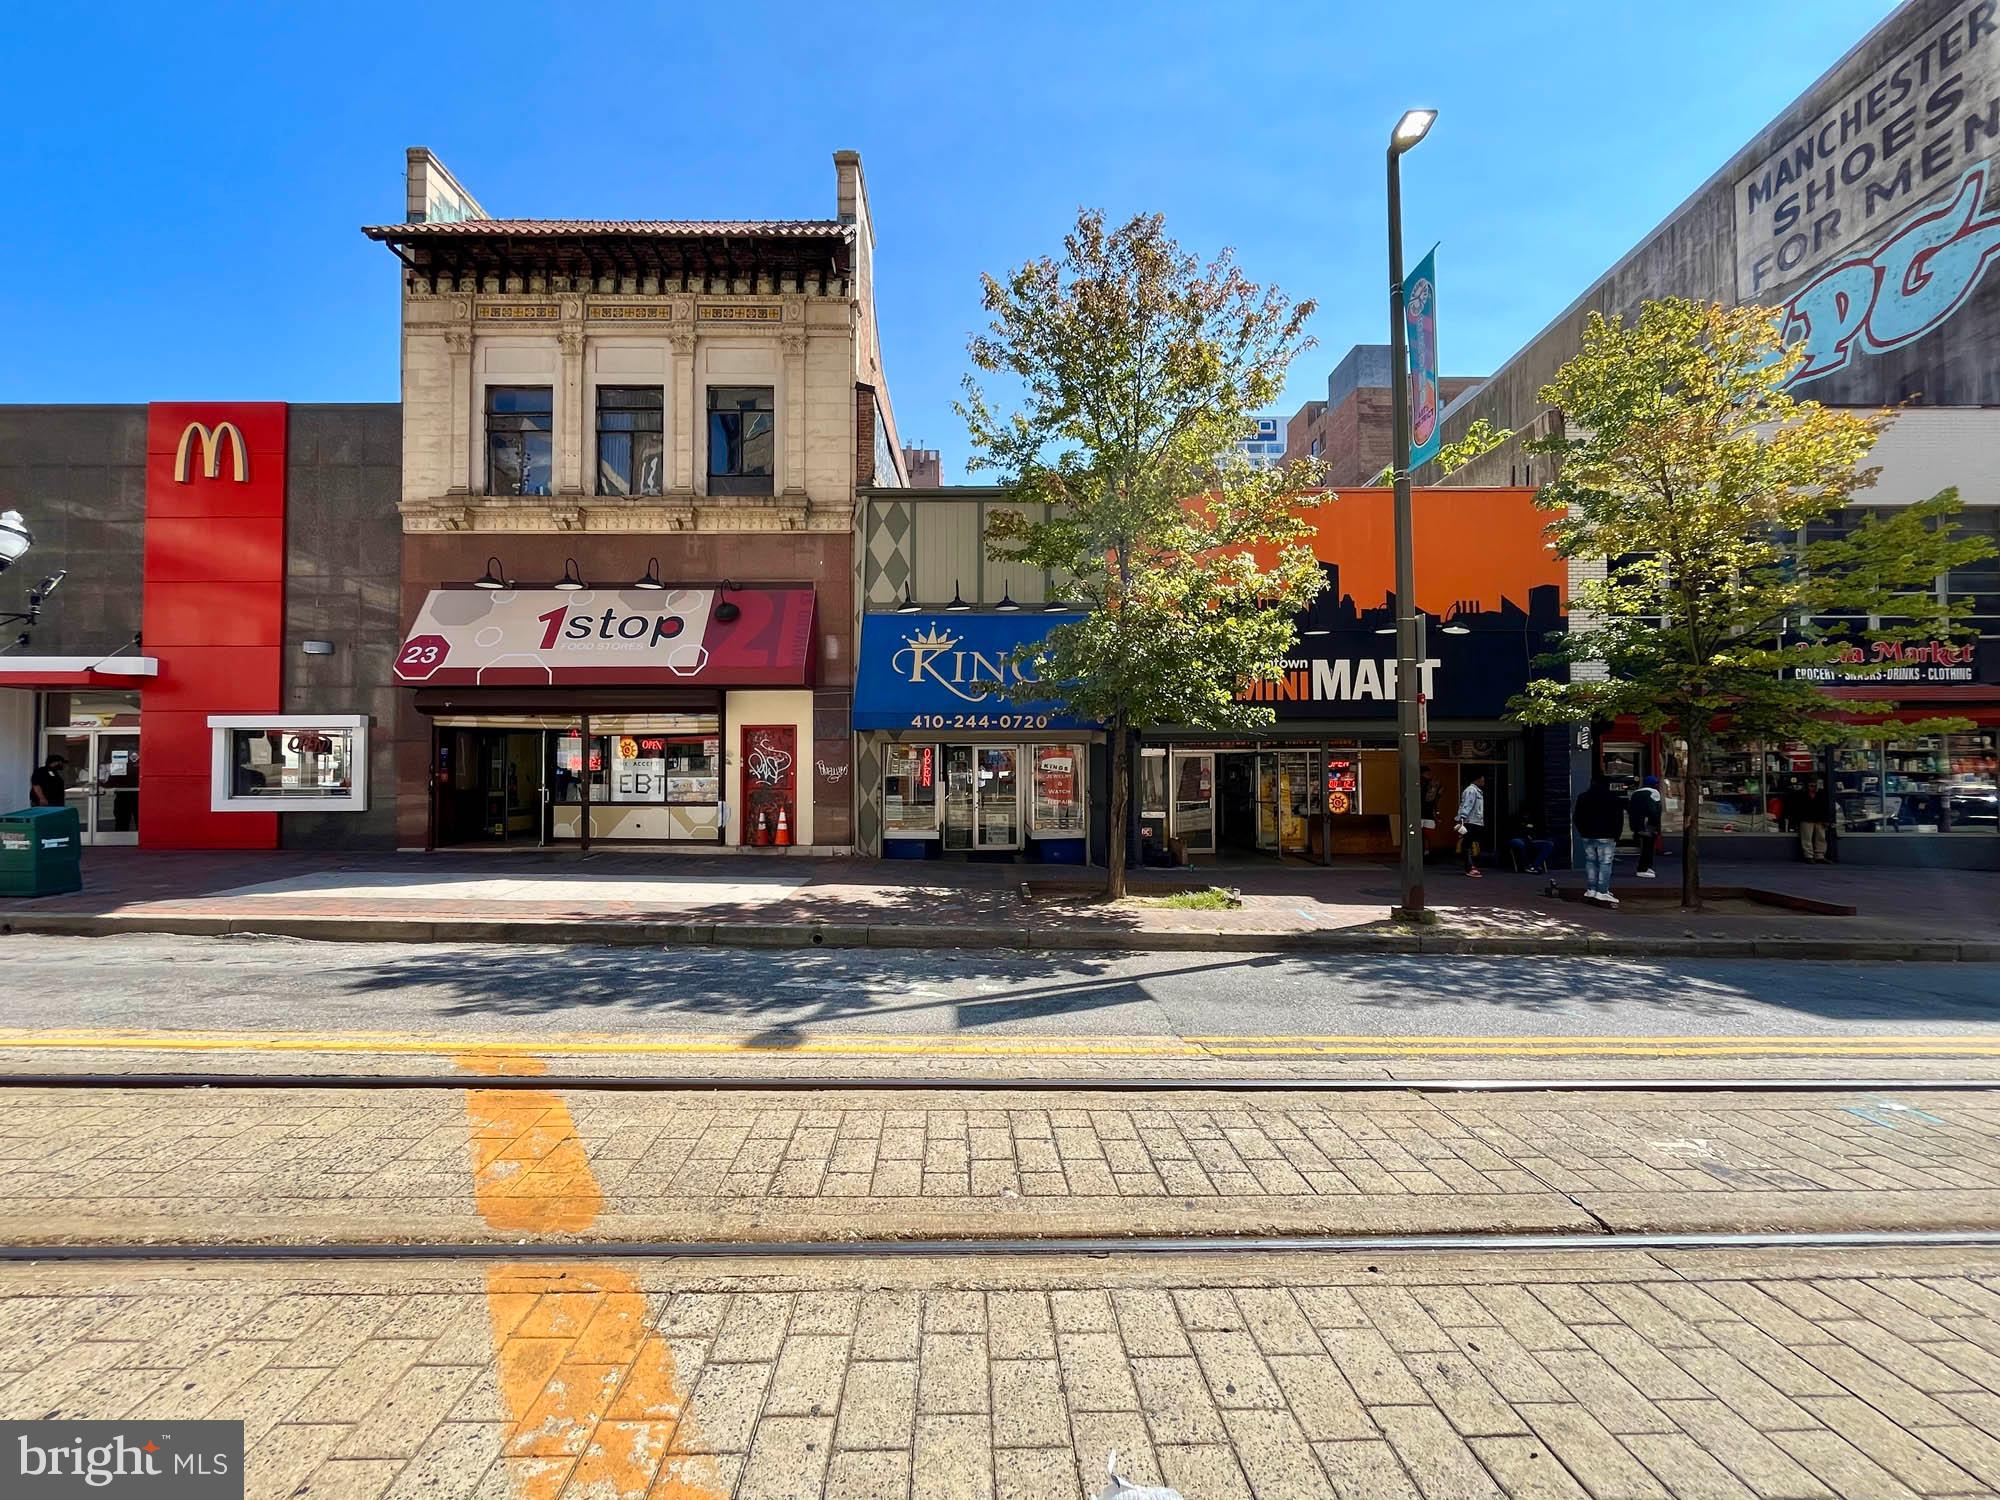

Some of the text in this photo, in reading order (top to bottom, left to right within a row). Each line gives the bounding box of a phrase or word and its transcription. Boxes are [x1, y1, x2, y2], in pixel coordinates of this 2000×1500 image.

[1748, 0, 1998, 214] MANCHESTER
[1775, 73, 1964, 236] SHOES
[1753, 97, 2000, 293] FOR MEN
[537, 604, 685, 650] 1stop
[402, 646, 439, 664] 23
[561, 642, 645, 650] FOOD STORES
[1869, 640, 1975, 668] Market
[1887, 668, 1920, 680] DRINKS
[1928, 668, 1972, 680] CLOTHING
[911, 714, 1048, 729] 410-244-0720
[641, 739, 662, 750] OPEN
[952, 751, 966, 761] 19
[922, 747, 933, 787] OPEN
[1043, 762, 1070, 772] KINGS
[620, 773, 665, 794] EBT
